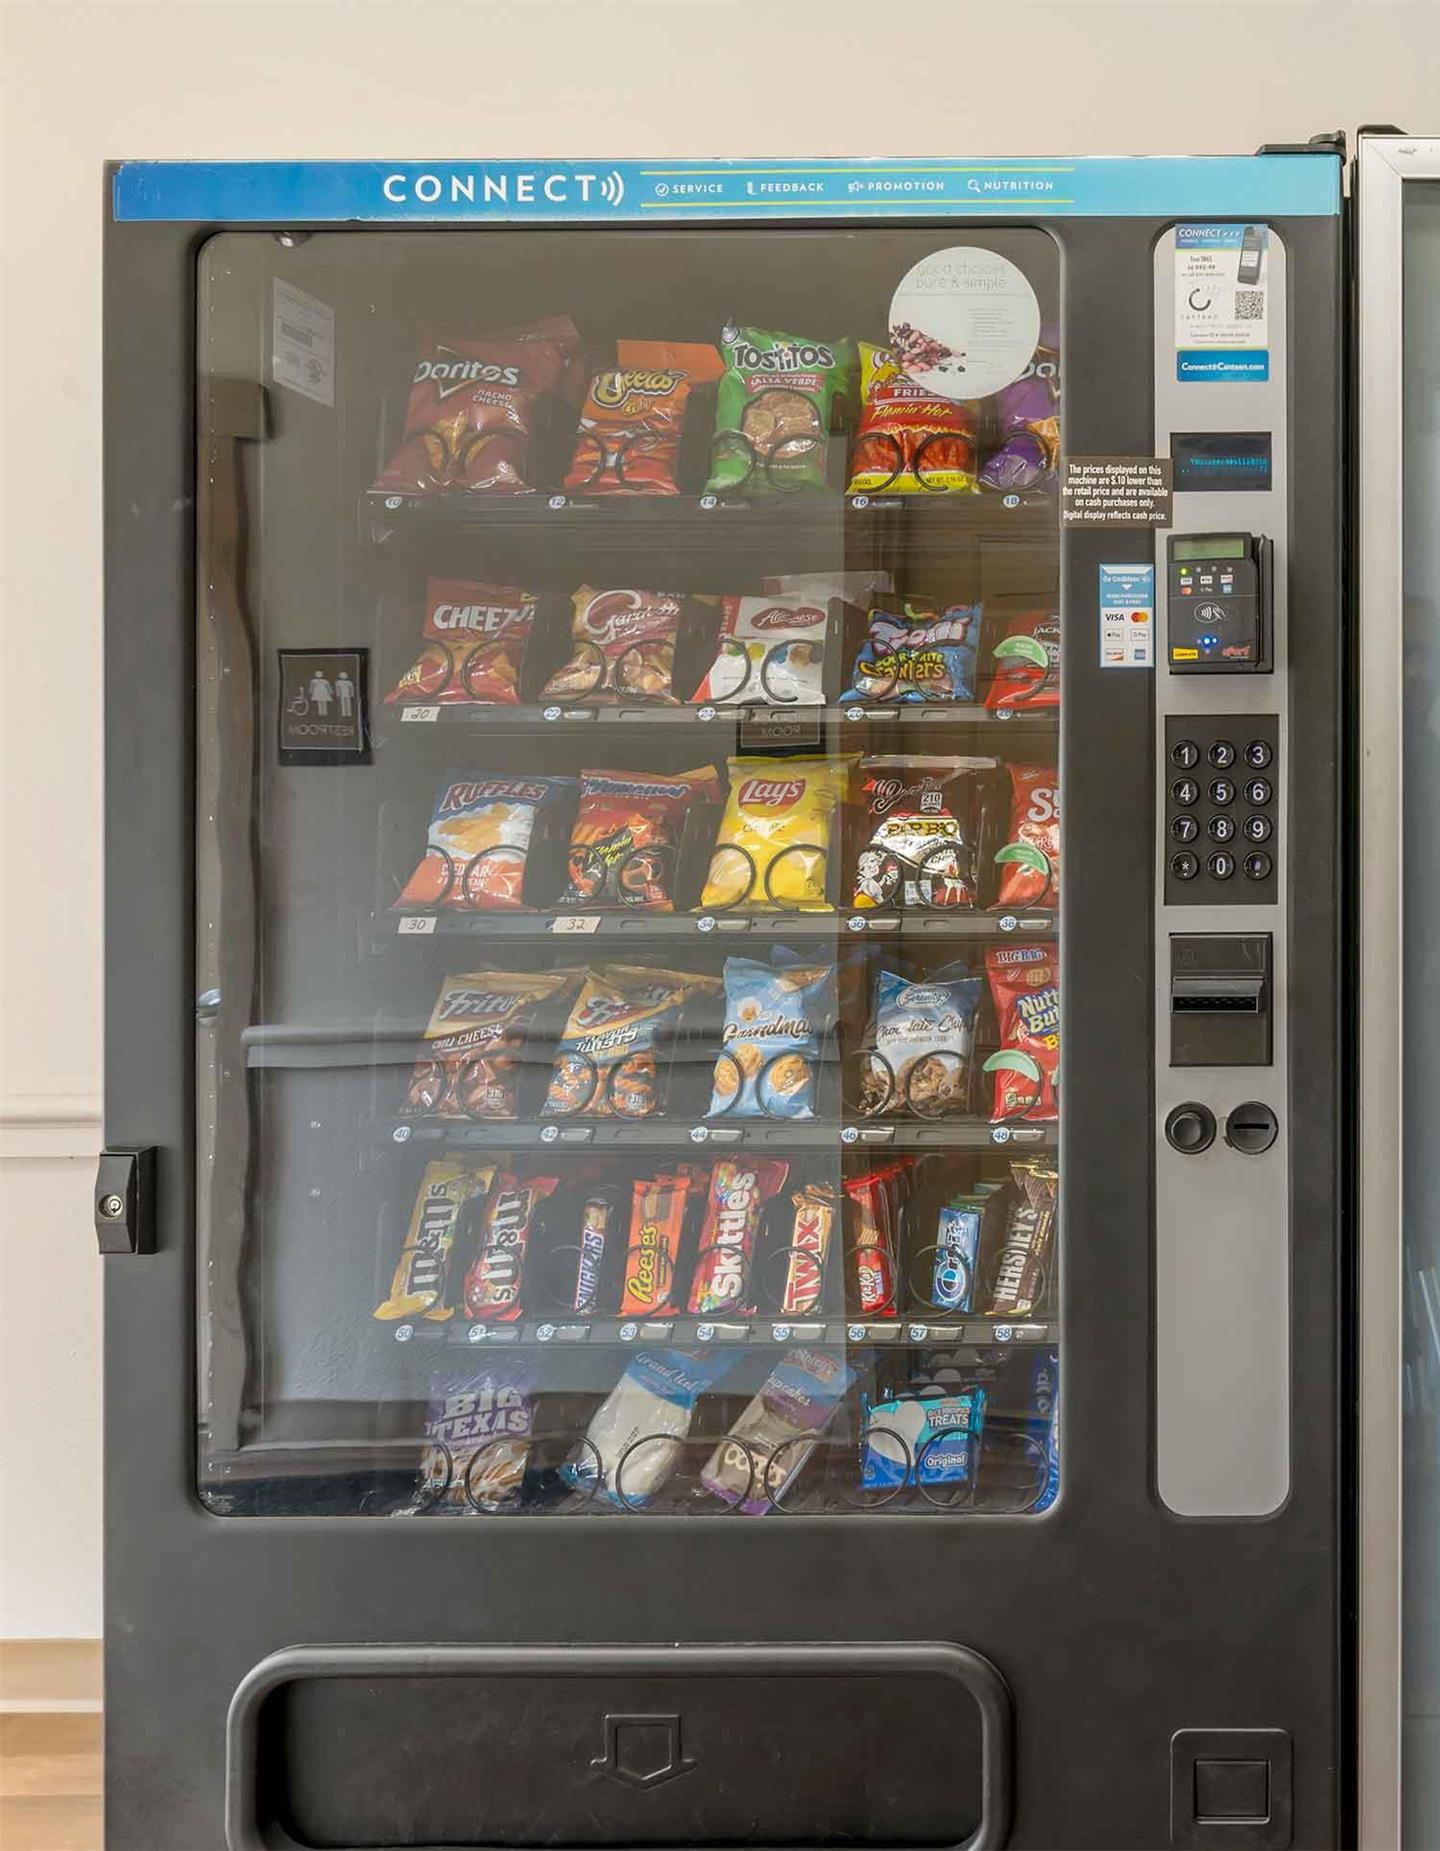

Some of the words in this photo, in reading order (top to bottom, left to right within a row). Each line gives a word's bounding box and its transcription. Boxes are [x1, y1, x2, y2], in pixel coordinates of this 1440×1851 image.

[383, 174, 596, 202] CONNECT
[673, 183, 723, 194] SERVICE
[761, 182, 825, 193] FEEDBACK
[868, 181, 945, 192] PROMOTION
[984, 180, 1053, 192] NUTRITION
[1178, 228, 1221, 238] CONNECT
[414, 360, 520, 385] Doritos
[1069, 464, 1081, 474] The
[1083, 464, 1104, 478] prices
[1105, 464, 1138, 476] displayed
[1148, 464, 1162, 475] this
[1068, 475, 1097, 485] machine
[1110, 476, 1126, 486] $.10
[1127, 476, 1146, 485] lower
[1147, 476, 1162, 485] than
[1062, 486, 1073, 496] the
[1074, 487, 1091, 496] retail
[1092, 487, 1110, 498] price
[1110, 487, 1125, 496] and
[1138, 487, 1168, 497] available
[1085, 498, 1101, 507] cash
[1102, 498, 1138, 509] purchases
[1139, 498, 1155, 509] only.
[1063, 510, 1083, 520] Digital
[1083, 511, 1106, 521] display
[1107, 511, 1131, 520] reflects
[1132, 511, 1148, 520] cash
[1148, 512, 1167, 521] price.
[1105, 613, 1125, 621] VISA
[1181, 747, 1190, 764] 1
[1216, 747, 1227, 763] 2
[1252, 747, 1263, 764] 3
[743, 778, 805, 805] Lay's
[1179, 784, 1191, 800] 4
[1215, 784, 1227, 800] 5
[1252, 784, 1264, 800] 6
[1180, 821, 1191, 838] 7
[1216, 821, 1228, 838] 8
[1252, 821, 1264, 838] 9
[1215, 857, 1226, 875] 0
[408, 919, 426, 930] 30
[567, 919, 585, 930] 32
[997, 950, 1020, 963] BIG
[628, 1224, 658, 1304] Reese's
[785, 1218, 822, 1311] TWIX
[445, 1386, 521, 1416] BIG
[434, 1410, 529, 1441] TEXAS
[929, 1413, 969, 1427] TREATS
[926, 1453, 967, 1468] Original
